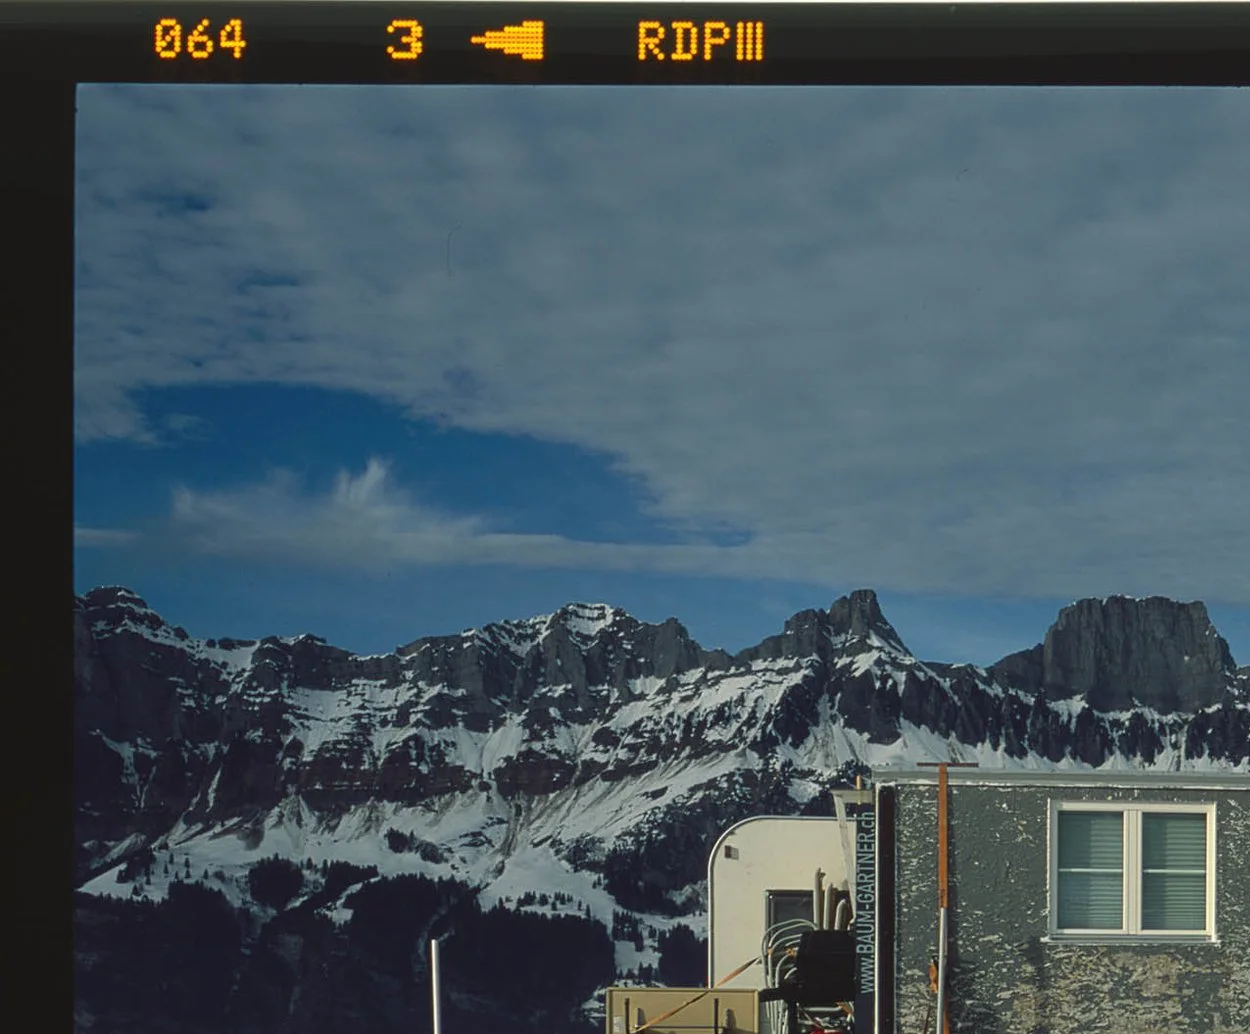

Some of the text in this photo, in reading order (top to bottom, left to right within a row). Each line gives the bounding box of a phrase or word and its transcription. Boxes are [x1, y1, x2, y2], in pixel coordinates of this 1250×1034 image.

[154, 18, 247, 59] 064
[386, 19, 424, 60] 3
[856, 811, 875, 994] www.BAUM-GARTNER.ch
